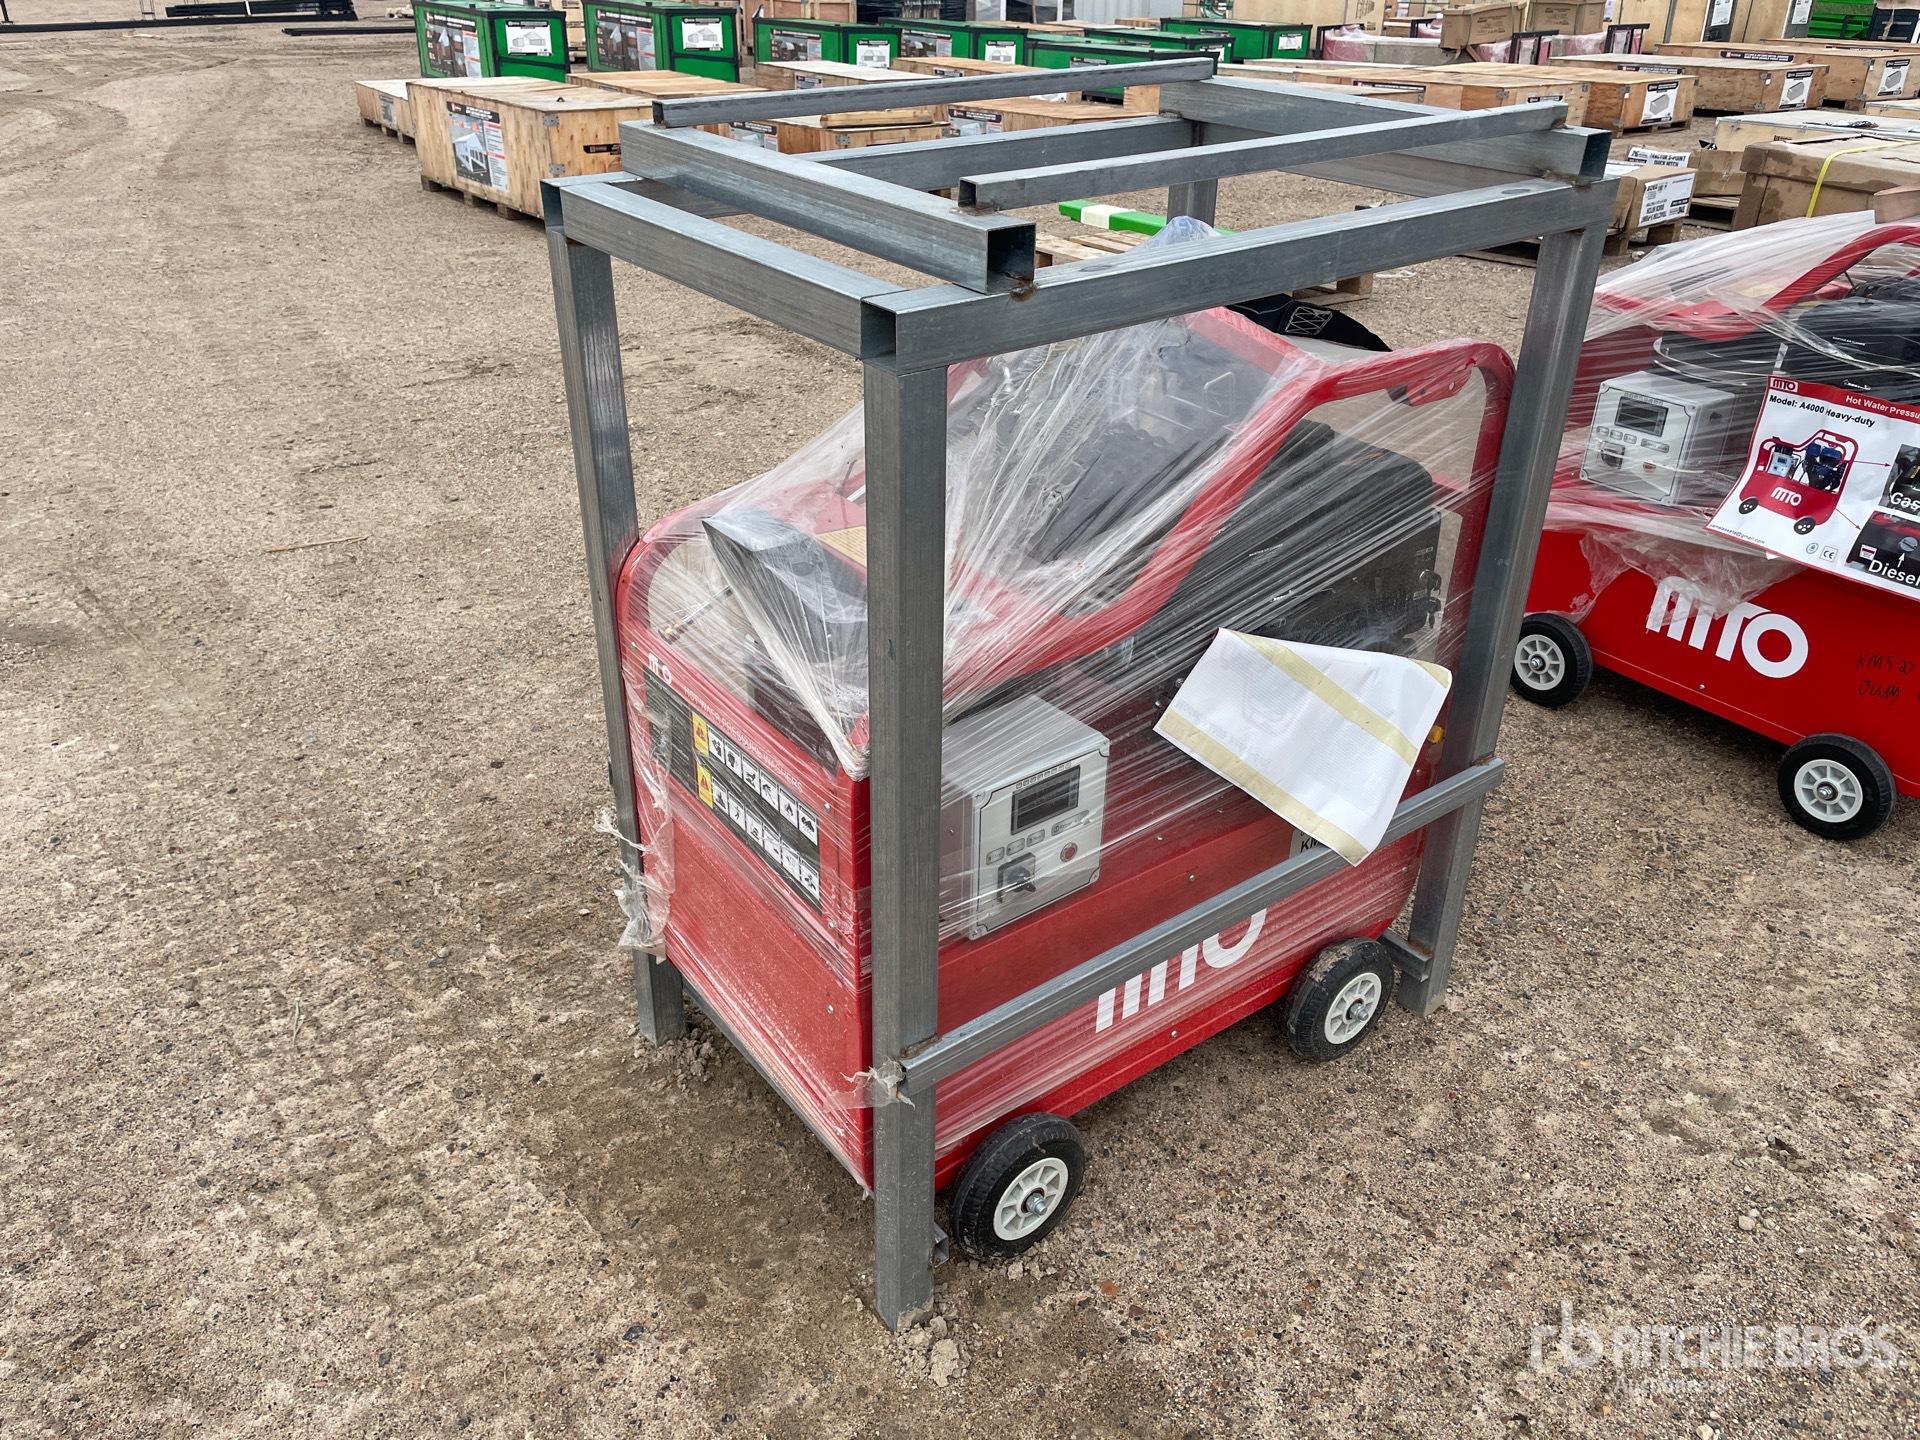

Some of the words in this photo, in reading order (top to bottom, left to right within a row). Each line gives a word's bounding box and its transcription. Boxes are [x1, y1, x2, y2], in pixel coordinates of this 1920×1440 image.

[1769, 395, 1797, 408] Model:
[1799, 402, 1825, 414] A4000
[1845, 395, 1861, 406] Hot
[1863, 400, 1889, 412] Water
[1645, 575, 1809, 678] MTO
